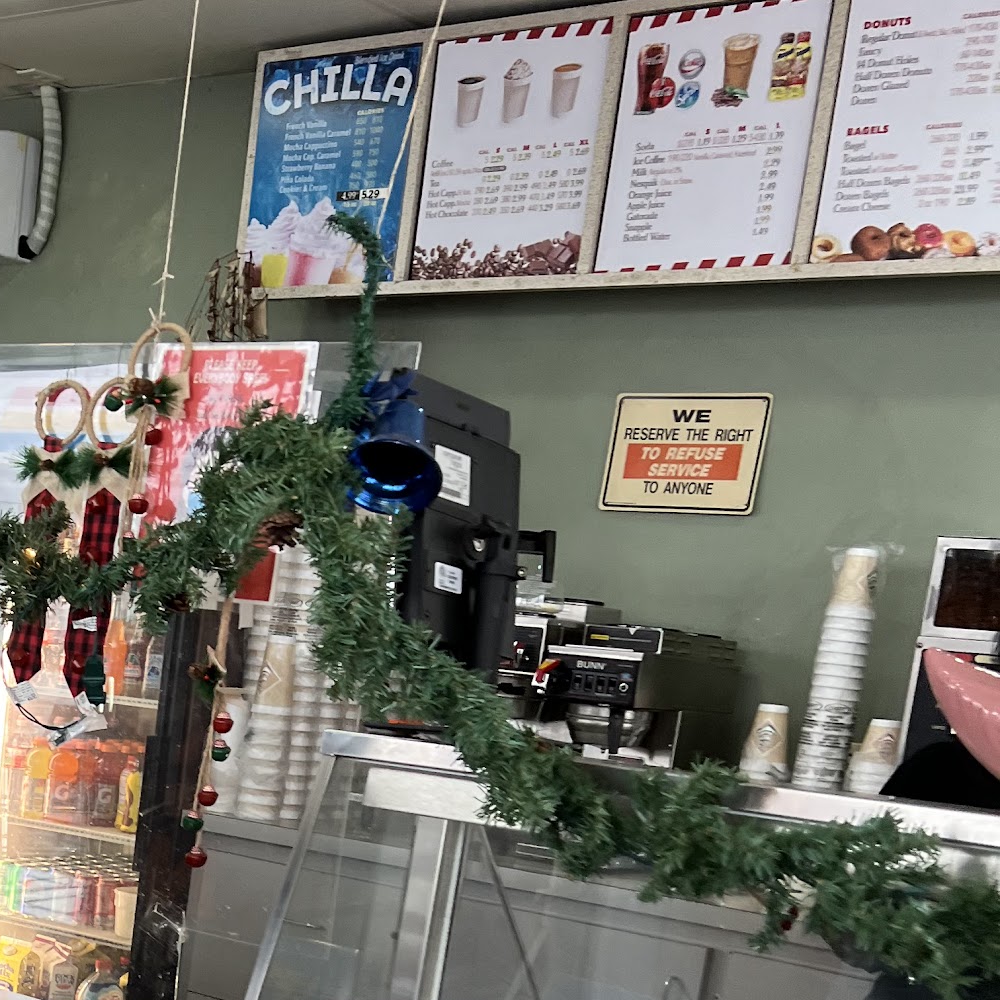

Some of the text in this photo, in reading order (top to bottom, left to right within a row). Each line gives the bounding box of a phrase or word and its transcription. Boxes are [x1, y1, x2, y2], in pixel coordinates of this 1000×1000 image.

[864, 17, 912, 30] DONUTS
[264, 63, 414, 116] CHILLA
[846, 125, 890, 137] BAGELS
[362, 189, 380, 199] 5.29
[672, 410, 712, 423] WE
[624, 428, 754, 441] RESERVE THE RIGHT
[641, 447, 726, 460] TO REFUSE
[648, 464, 712, 477] SERVICE
[644, 481, 714, 495] TO ANYONE
[577, 660, 605, 670] BUNN
